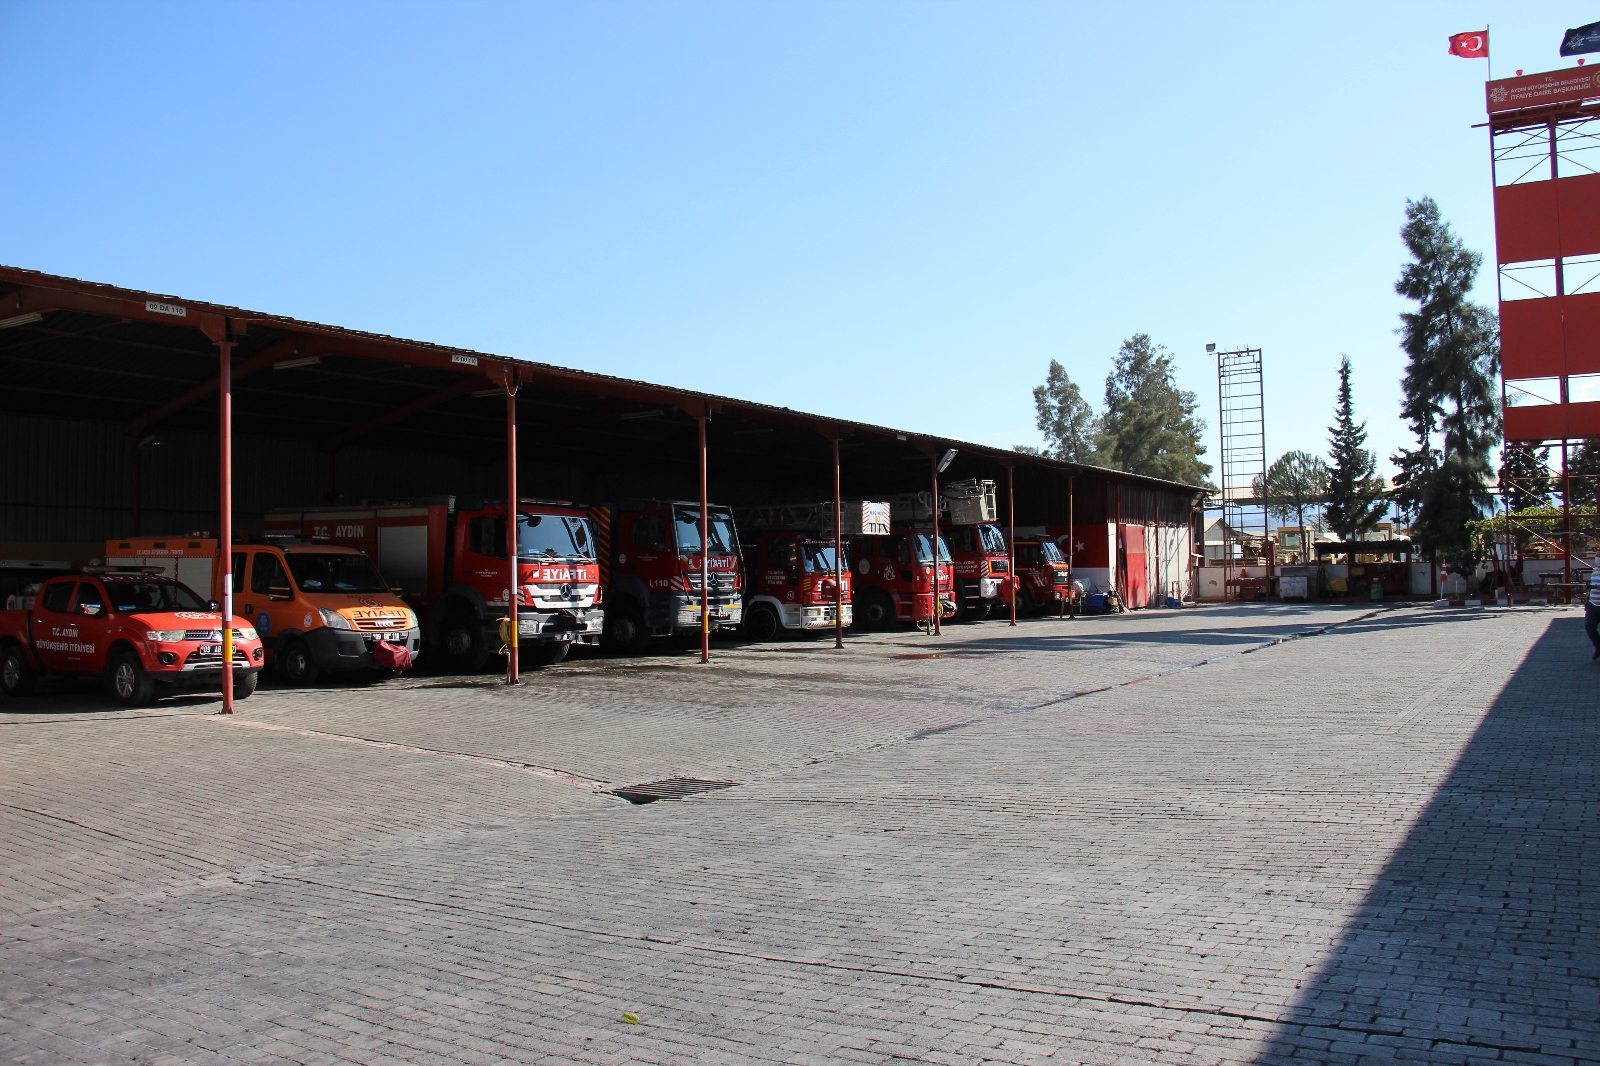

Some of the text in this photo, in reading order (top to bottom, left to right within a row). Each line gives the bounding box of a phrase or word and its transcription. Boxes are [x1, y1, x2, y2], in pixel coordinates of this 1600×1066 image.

[1510, 86, 1527, 94] AYDIN
[1510, 83, 1591, 101] İTFAİYE DAİRE BAŞKANLIĞI
[159, 304, 170, 312] DA
[314, 525, 364, 538] T.C. AYDIN
[655, 579, 669, 587] 110
[52, 627, 79, 638] T.C. AYDIN
[36, 639, 95, 654] BÜYÜKŞEHİR İTFAİYESİ
